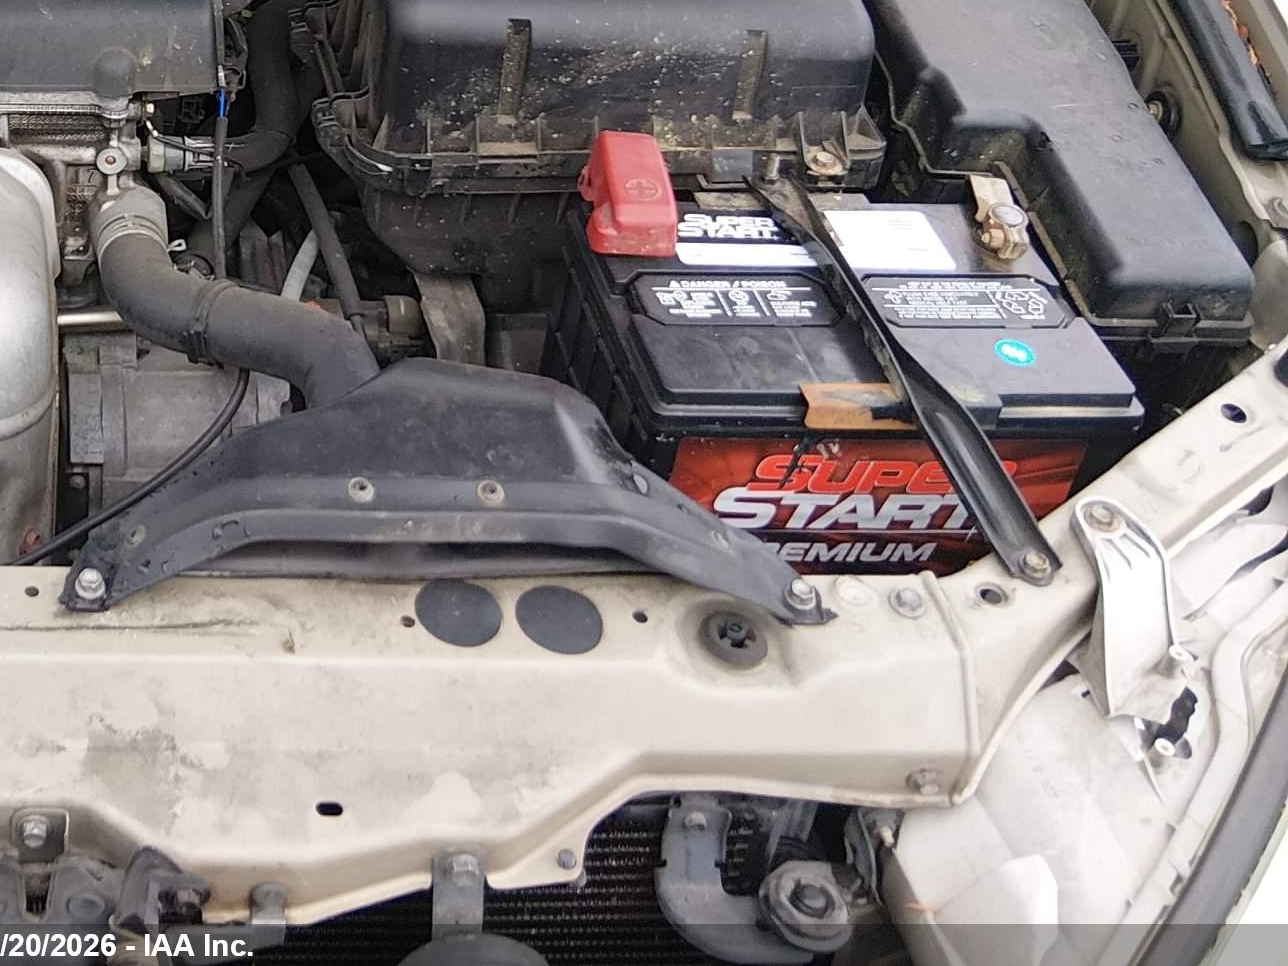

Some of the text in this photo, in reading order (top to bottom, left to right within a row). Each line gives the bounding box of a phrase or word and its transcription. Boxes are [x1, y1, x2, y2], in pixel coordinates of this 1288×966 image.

[677, 221, 779, 239] START
[683, 213, 774, 228] SUPER
[745, 454, 1018, 495] SUPE
[713, 486, 970, 531] START
[759, 541, 937, 563] EMIUM
